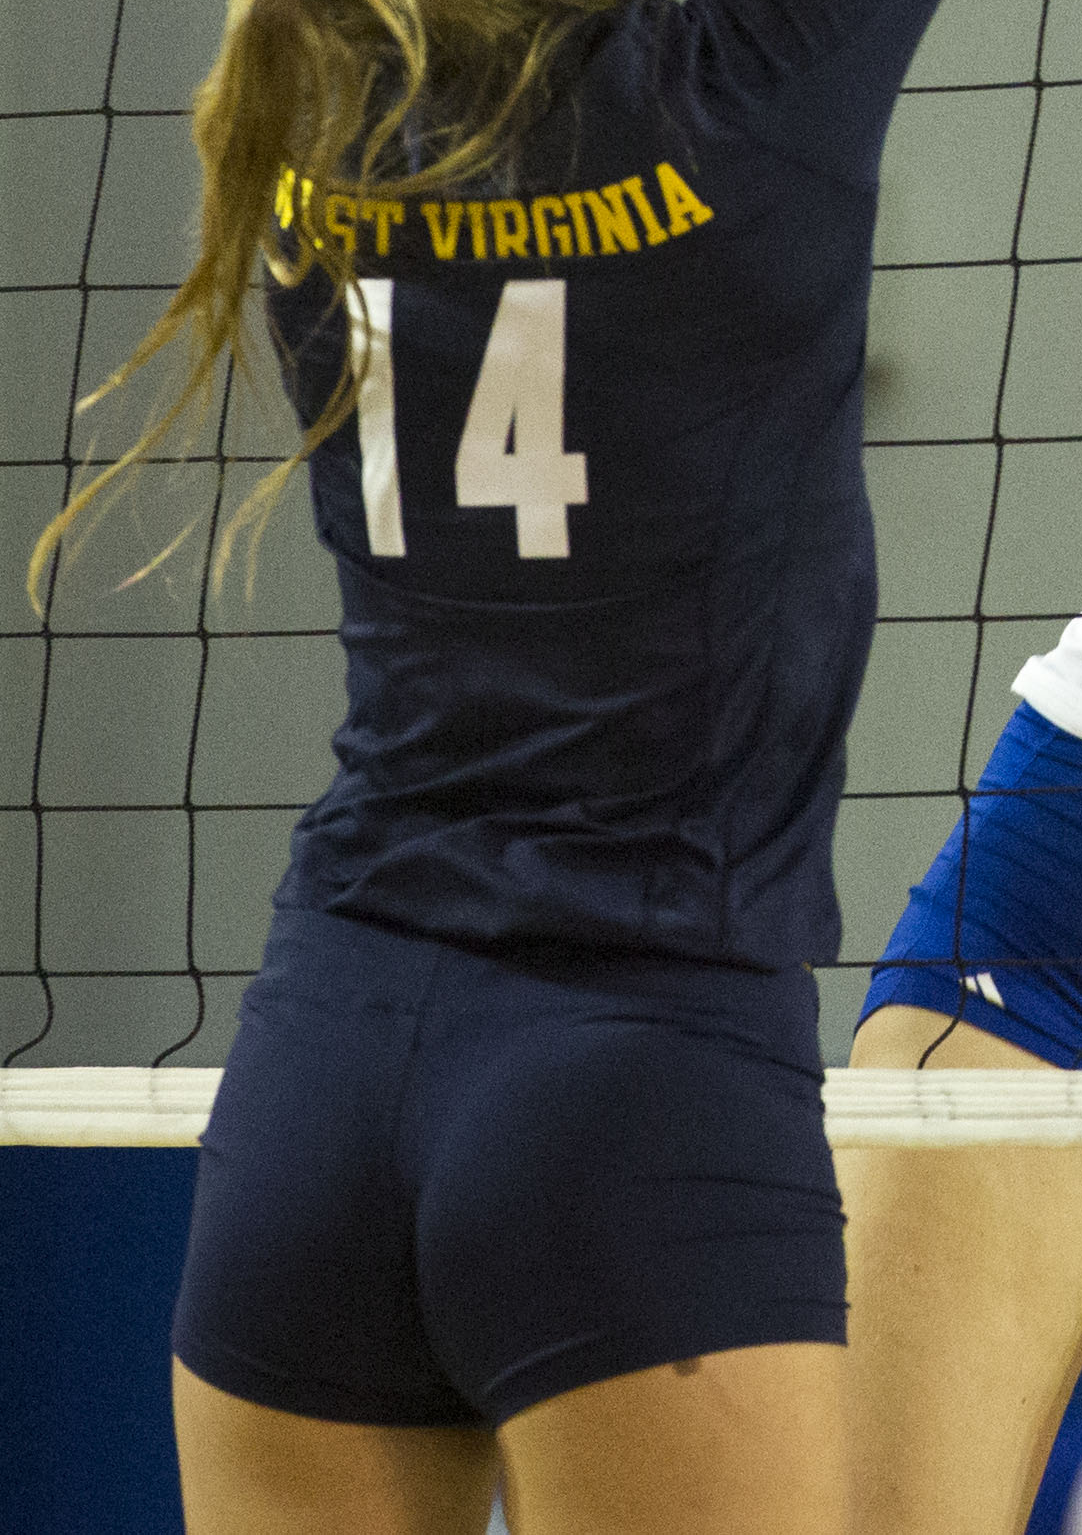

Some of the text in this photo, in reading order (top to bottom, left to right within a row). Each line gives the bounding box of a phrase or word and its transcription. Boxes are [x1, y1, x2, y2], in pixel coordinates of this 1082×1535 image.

[274, 162, 715, 260] ST VIRGINIA
[346, 277, 589, 559] 14
